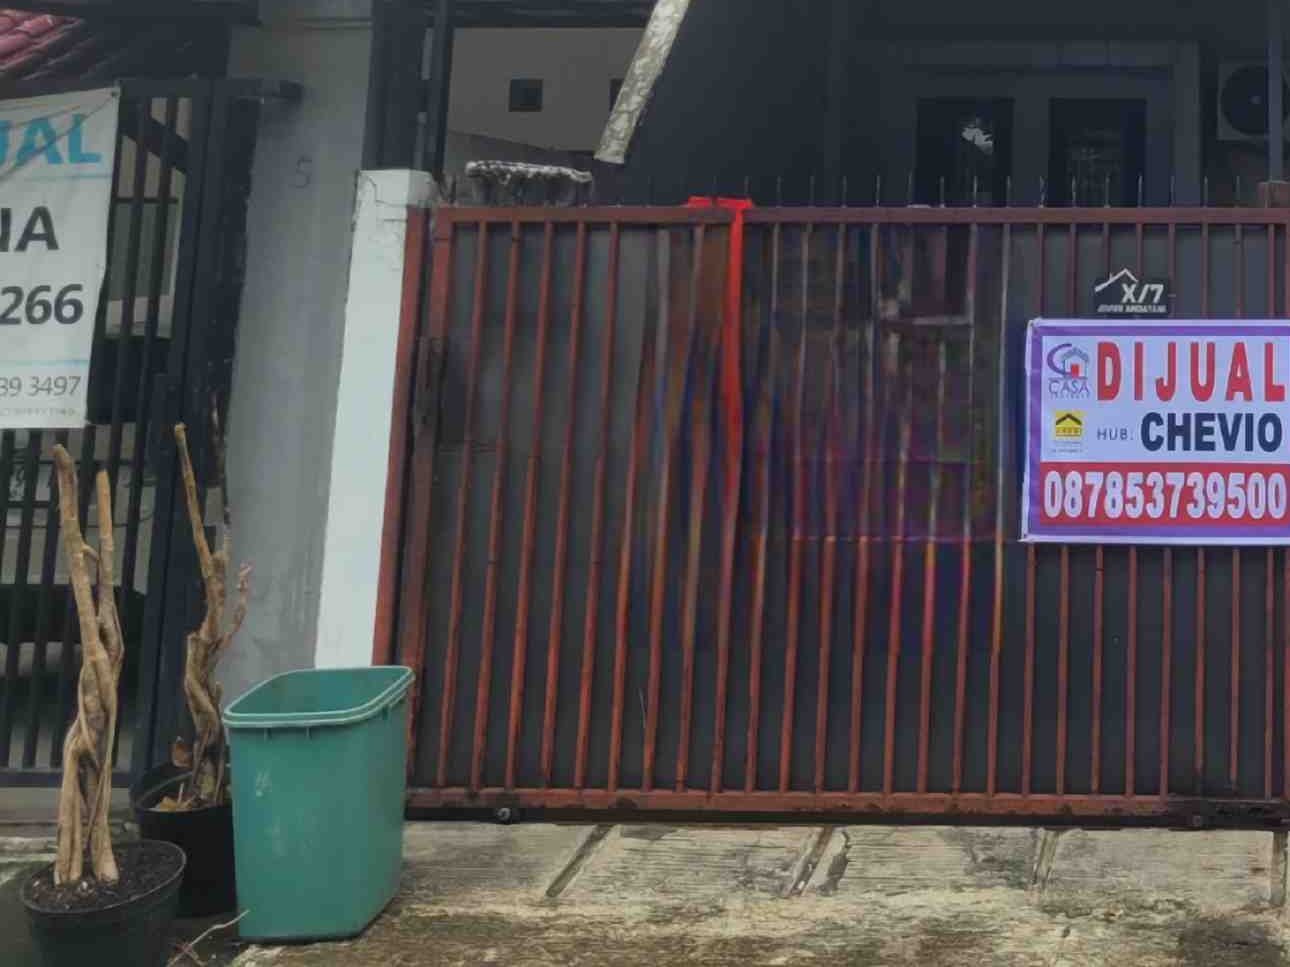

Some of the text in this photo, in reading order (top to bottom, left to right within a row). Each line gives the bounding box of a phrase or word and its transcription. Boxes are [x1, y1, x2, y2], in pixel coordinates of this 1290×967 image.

[0, 284, 83, 325] 266
[28, 376, 81, 396] 3497
[1049, 380, 1089, 393] CASA
[1097, 342, 1286, 401] DIJUAL
[1141, 412, 1283, 451] CHEVIO
[1043, 470, 1288, 520] 087853739500
